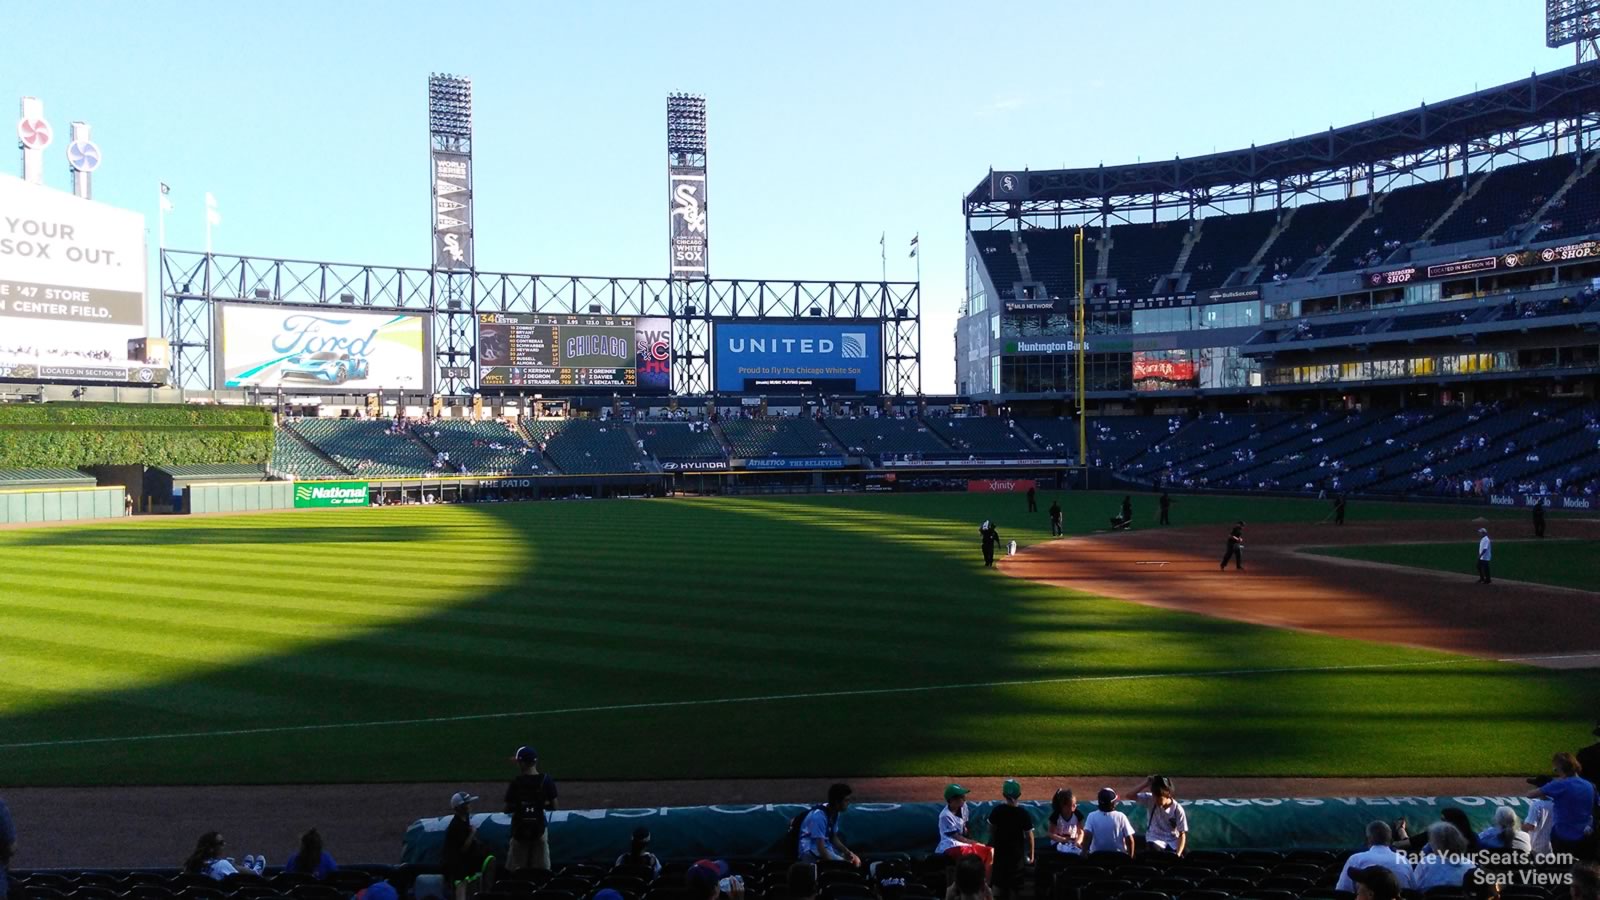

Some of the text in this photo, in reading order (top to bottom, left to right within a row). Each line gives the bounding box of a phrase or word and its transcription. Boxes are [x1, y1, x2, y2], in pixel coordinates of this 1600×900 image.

[437, 160, 466, 169] WORLD
[5, 216, 75, 240] YOUR
[0, 238, 121, 267] SOX OUT.
[1555, 241, 1597, 253] SCOREBOARD
[676, 251, 703, 261] SOX
[1561, 248, 1591, 260] SHOP
[1430, 266, 1455, 277] LOCATED
[1462, 262, 1485, 272] SECTION
[1485, 259, 1495, 267] 164
[1386, 275, 1411, 284] SHOP
[45, 289, 90, 302] STORE
[12, 301, 67, 315] CENTER
[71, 305, 113, 318] FIELD.
[480, 313, 496, 324] 34
[271, 314, 379, 357] Ford
[566, 334, 628, 360] CHICAGO
[729, 338, 834, 353] UNITED
[1017, 341, 1067, 354] Huntington
[1067, 341, 1090, 351] Bak
[42, 367, 126, 379] LOCATED IN SECTION 164
[738, 366, 760, 374] Proud
[771, 366, 781, 375] fly
[783, 366, 795, 374] the
[796, 367, 825, 375] Chicago
[748, 459, 786, 467] ATHLETICO
[480, 480, 530, 488] THE PATIO
[989, 480, 1016, 491] xfinity
[312, 486, 368, 499] National
[1491, 495, 1514, 505] Modelo
[1563, 497, 1590, 508] Modelo
